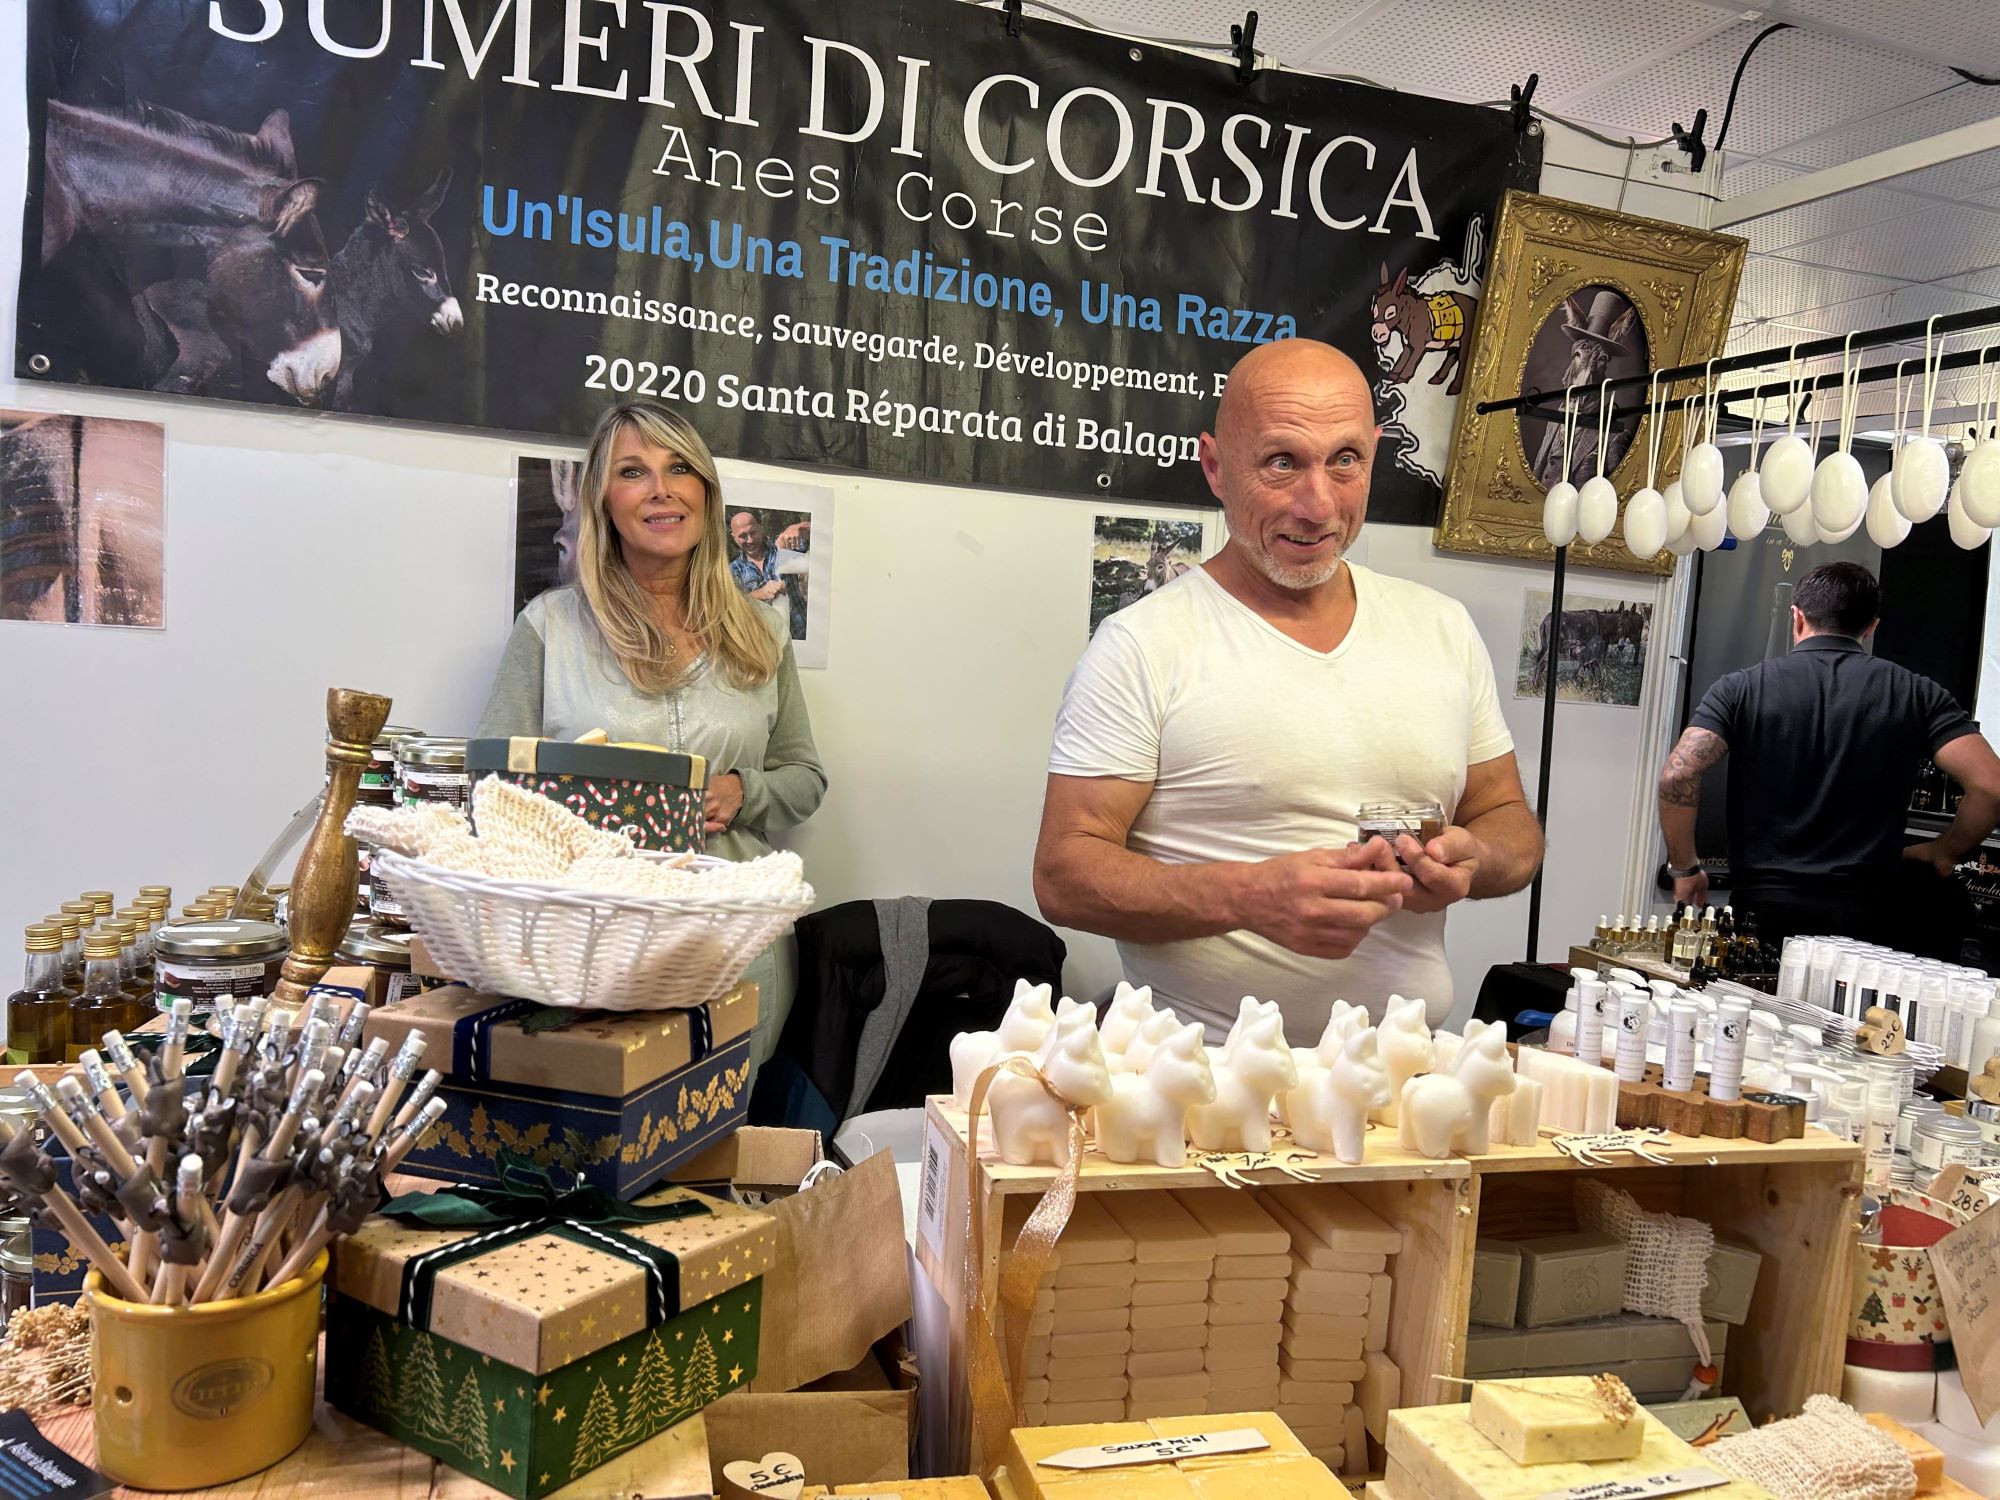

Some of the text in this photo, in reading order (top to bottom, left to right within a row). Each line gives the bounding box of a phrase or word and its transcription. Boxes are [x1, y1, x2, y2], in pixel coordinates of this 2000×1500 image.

[652, 125, 1108, 251] Anes Corse
[799, 36, 930, 158] DI
[964, 75, 1439, 241] CORSICA
[476, 273, 762, 344] Reconnaissance,
[773, 314, 965, 371] Sauvegarde,
[974, 343, 1204, 400] Développement,
[821, 236, 1063, 327] Tradizione,
[1082, 281, 1161, 331] Una
[1178, 294, 1296, 343] Razza
[585, 355, 1200, 467] 20220 Santa Réparata di Balagn
[1952, 1189, 1984, 1212] 28€
[229, 1243, 264, 1288] CORSICA
[1167, 1434, 1208, 1446] Miel
